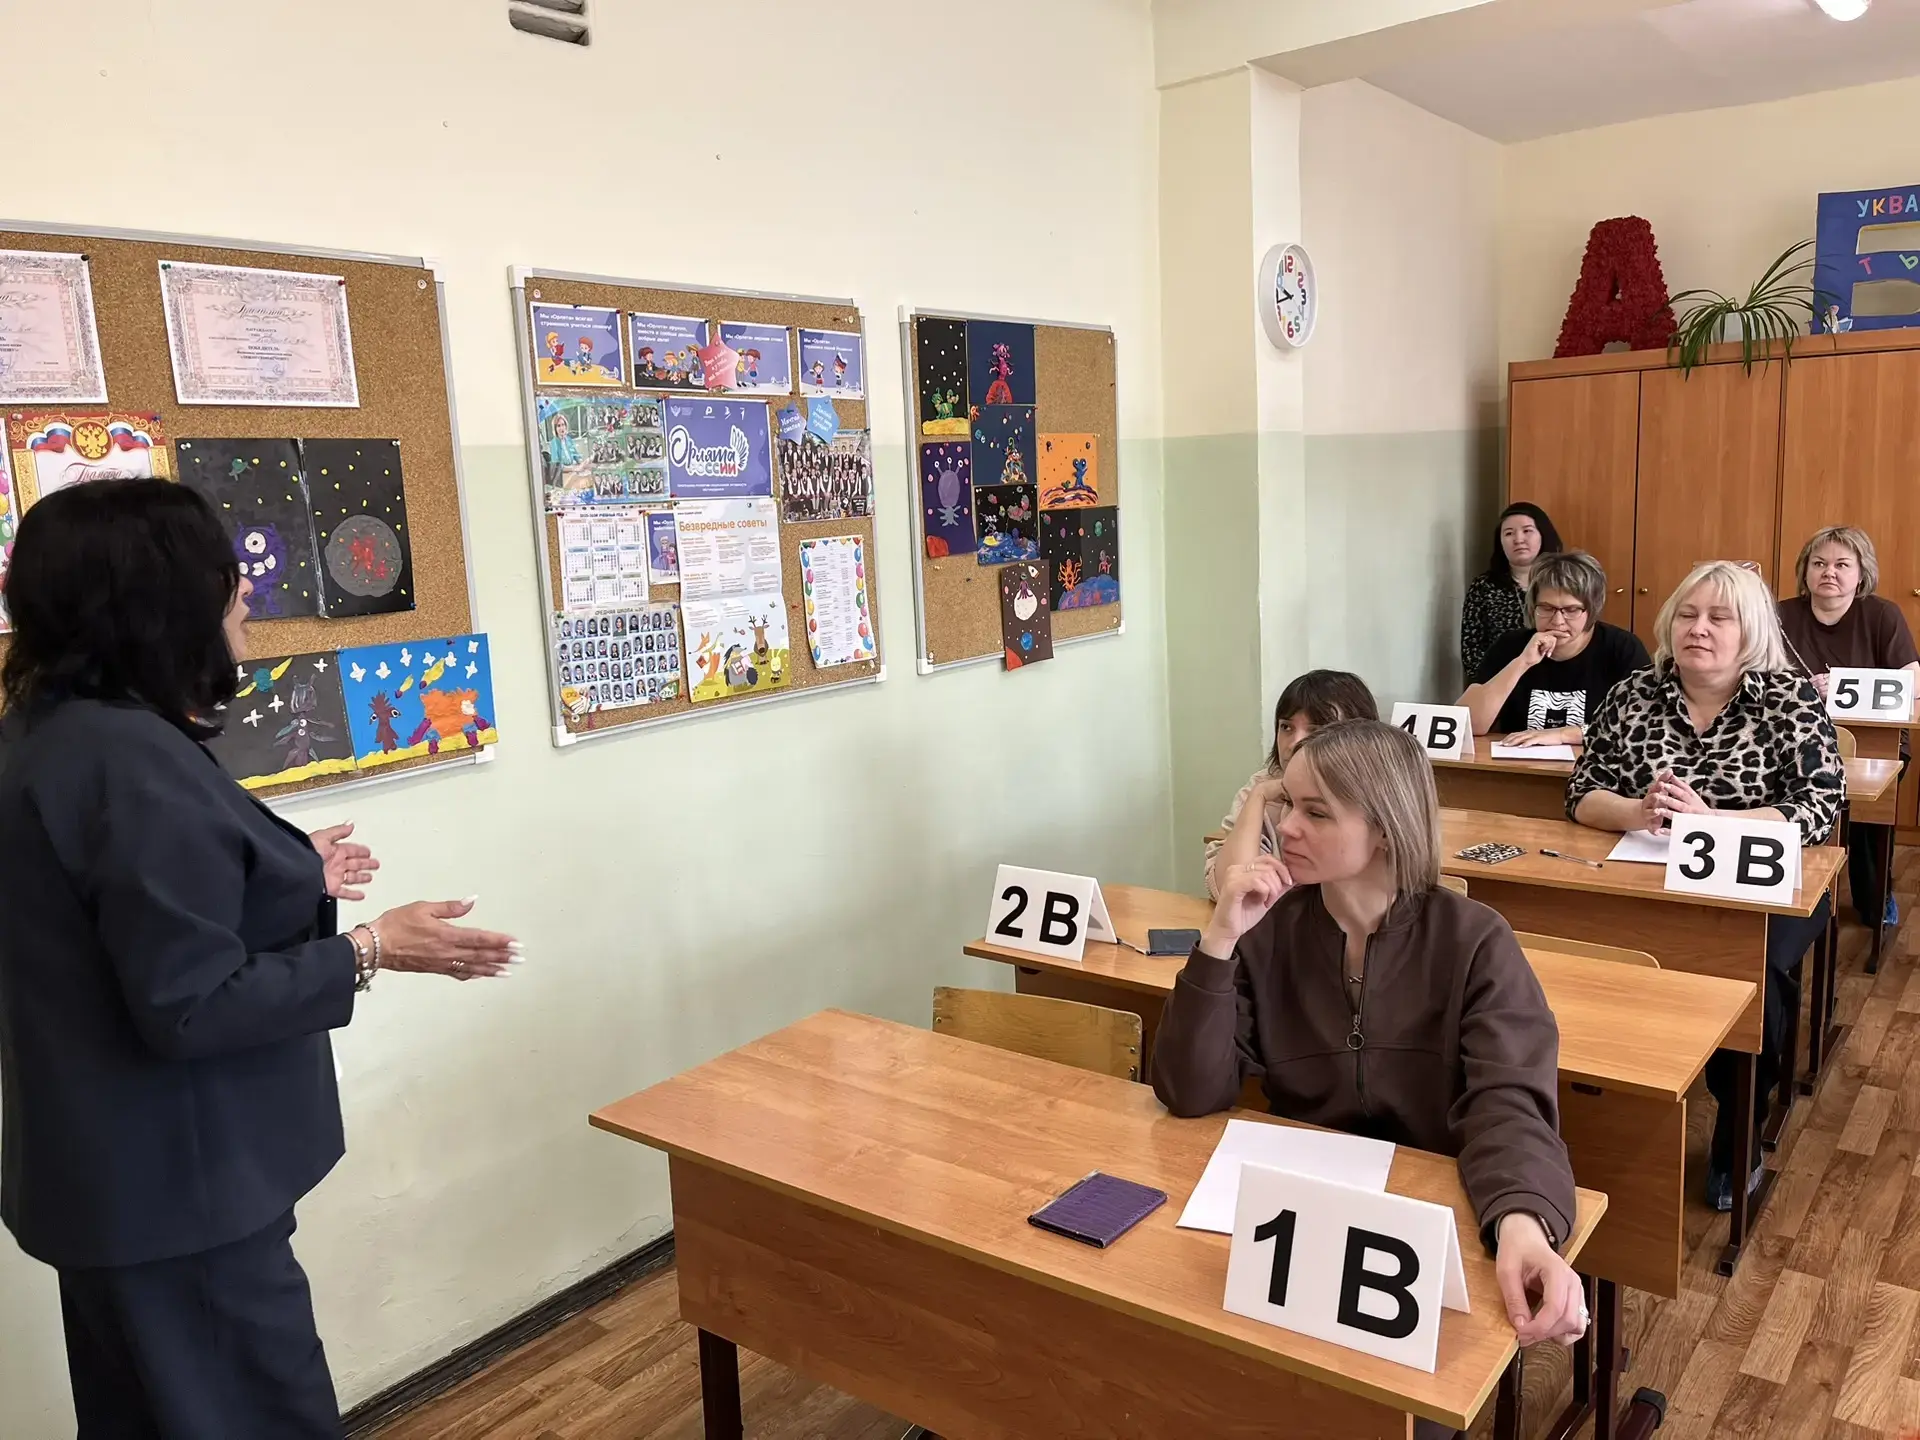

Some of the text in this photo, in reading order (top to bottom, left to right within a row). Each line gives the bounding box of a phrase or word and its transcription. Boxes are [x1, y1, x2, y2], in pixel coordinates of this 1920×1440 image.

[1300, 288, 1307, 306] 3
[1287, 320, 1294, 339] 6
[669, 426, 737, 470] Орлята
[687, 462, 738, 477] РОССИИ
[679, 520, 735, 533] Безвредные
[736, 519, 767, 529] советы
[1834, 678, 1904, 711] 5 В
[1427, 716, 1458, 750] В
[1678, 831, 1785, 887] 3 В
[994, 885, 1079, 946] 2 В
[1253, 1208, 1420, 1339] 1 В
